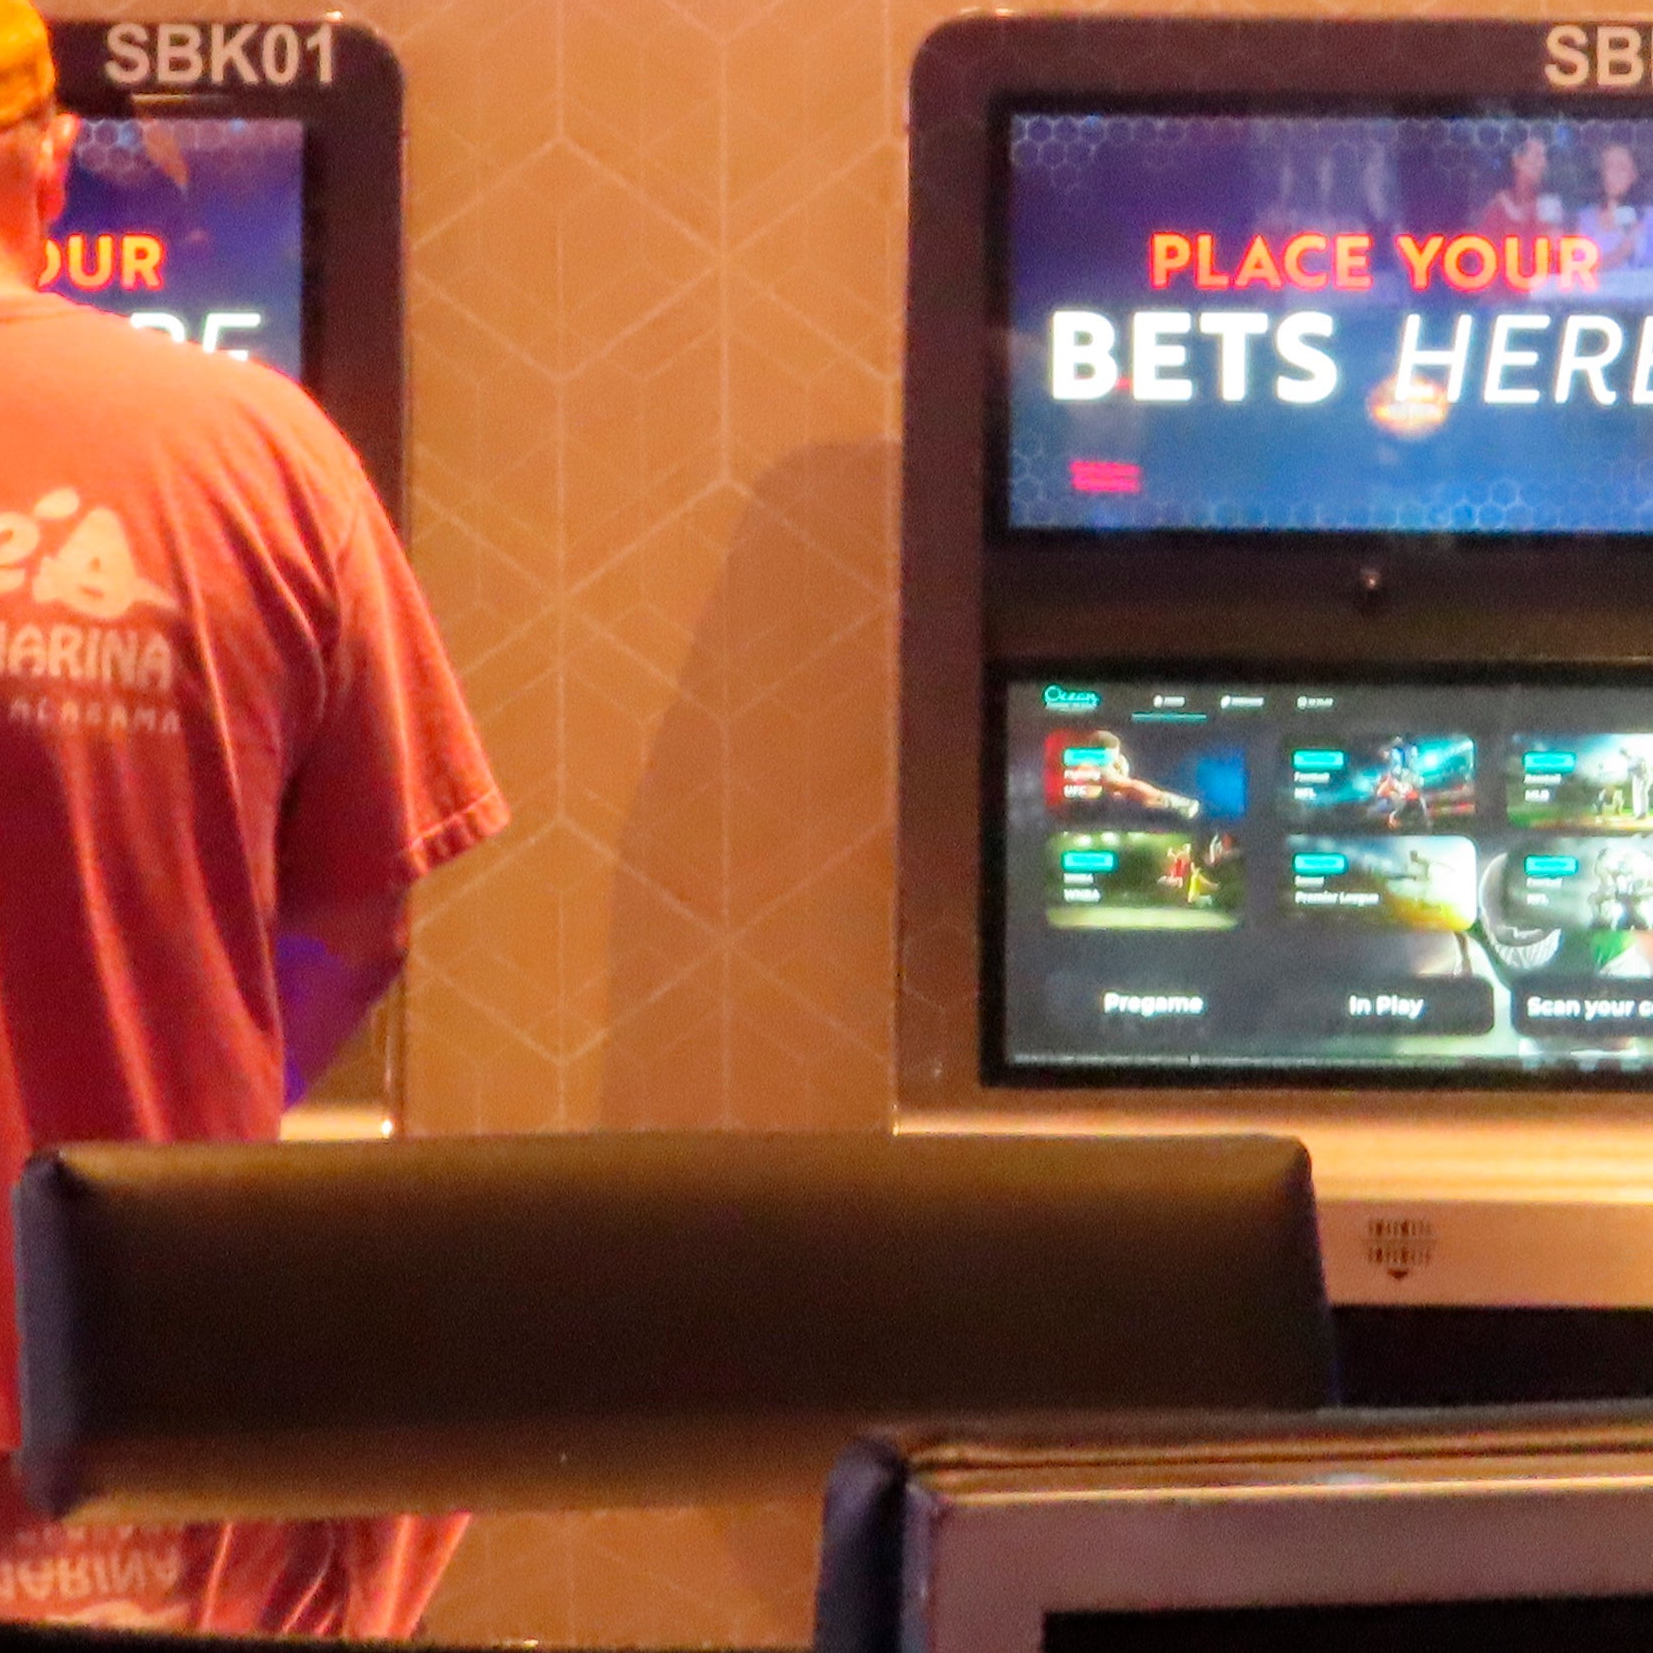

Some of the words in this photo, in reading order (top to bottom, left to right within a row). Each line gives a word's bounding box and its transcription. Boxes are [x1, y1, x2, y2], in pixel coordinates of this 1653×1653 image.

[105, 22, 338, 87] SBK01
[1150, 231, 1375, 291] PLACE
[1395, 232, 1601, 292] YOUR
[1050, 310, 1342, 404] BETS
[1102, 991, 1205, 1017] Pregame
[1349, 995, 1371, 1017] In
[1375, 995, 1425, 1019] Play
[1526, 996, 1581, 1018] Scan
[1584, 999, 1634, 1022] your
